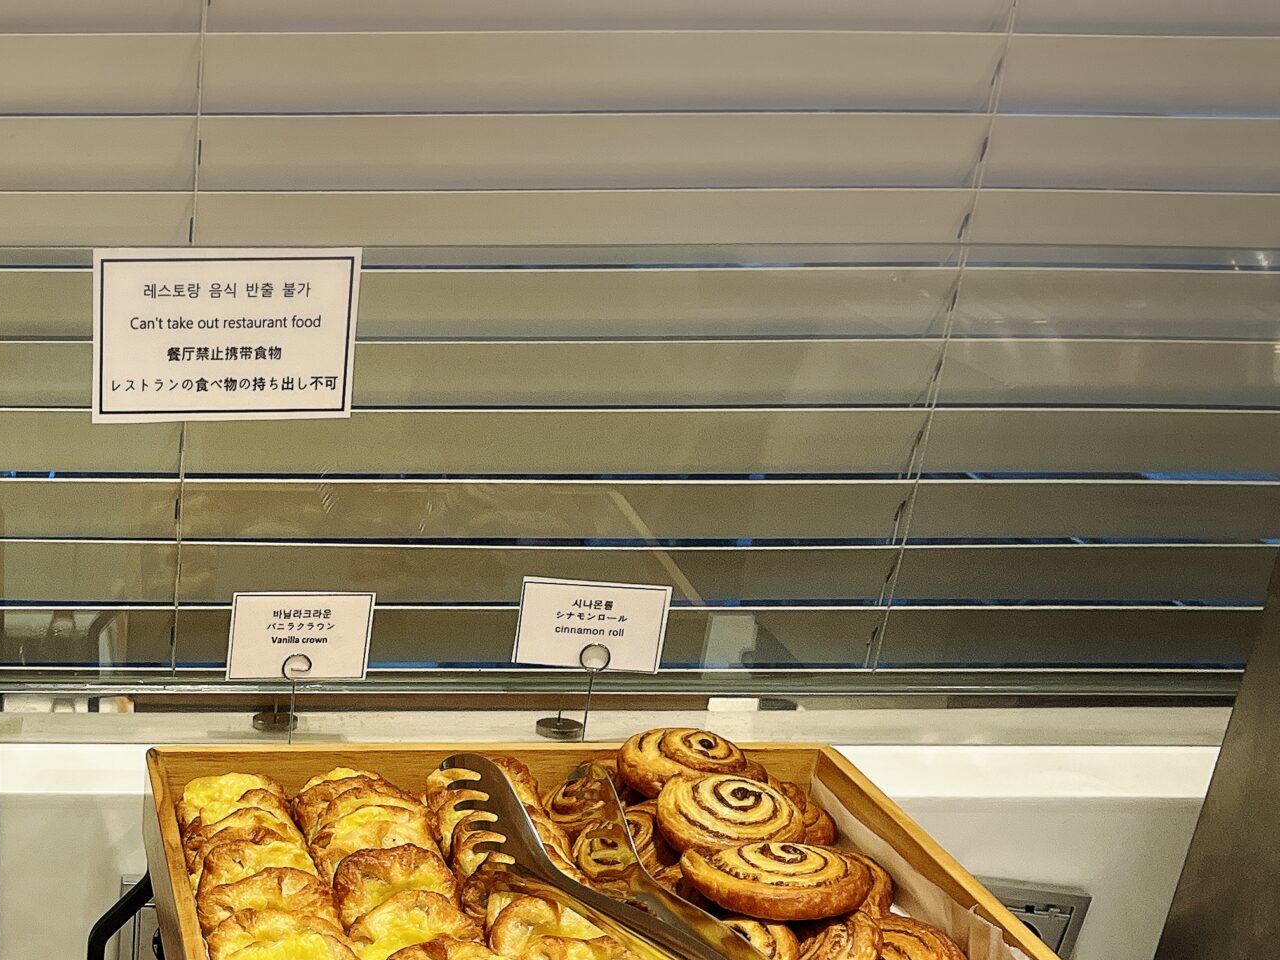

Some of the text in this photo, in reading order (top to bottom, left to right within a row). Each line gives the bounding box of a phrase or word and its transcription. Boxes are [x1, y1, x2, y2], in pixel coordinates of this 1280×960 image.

[143, 281, 312, 299] 레스토랑 음식 반출 불가
[130, 315, 322, 331] Can't take out restaurant food
[166, 346, 282, 362] 餐厅禁止携带食物
[111, 376, 339, 393] レストランの食べ物の持ち出し不可
[273, 609, 332, 620] 바닐라크라운
[556, 611, 628, 623] シナモンロール
[555, 625, 624, 637] cinnamon roll
[271, 636, 300, 644] Vanilla
